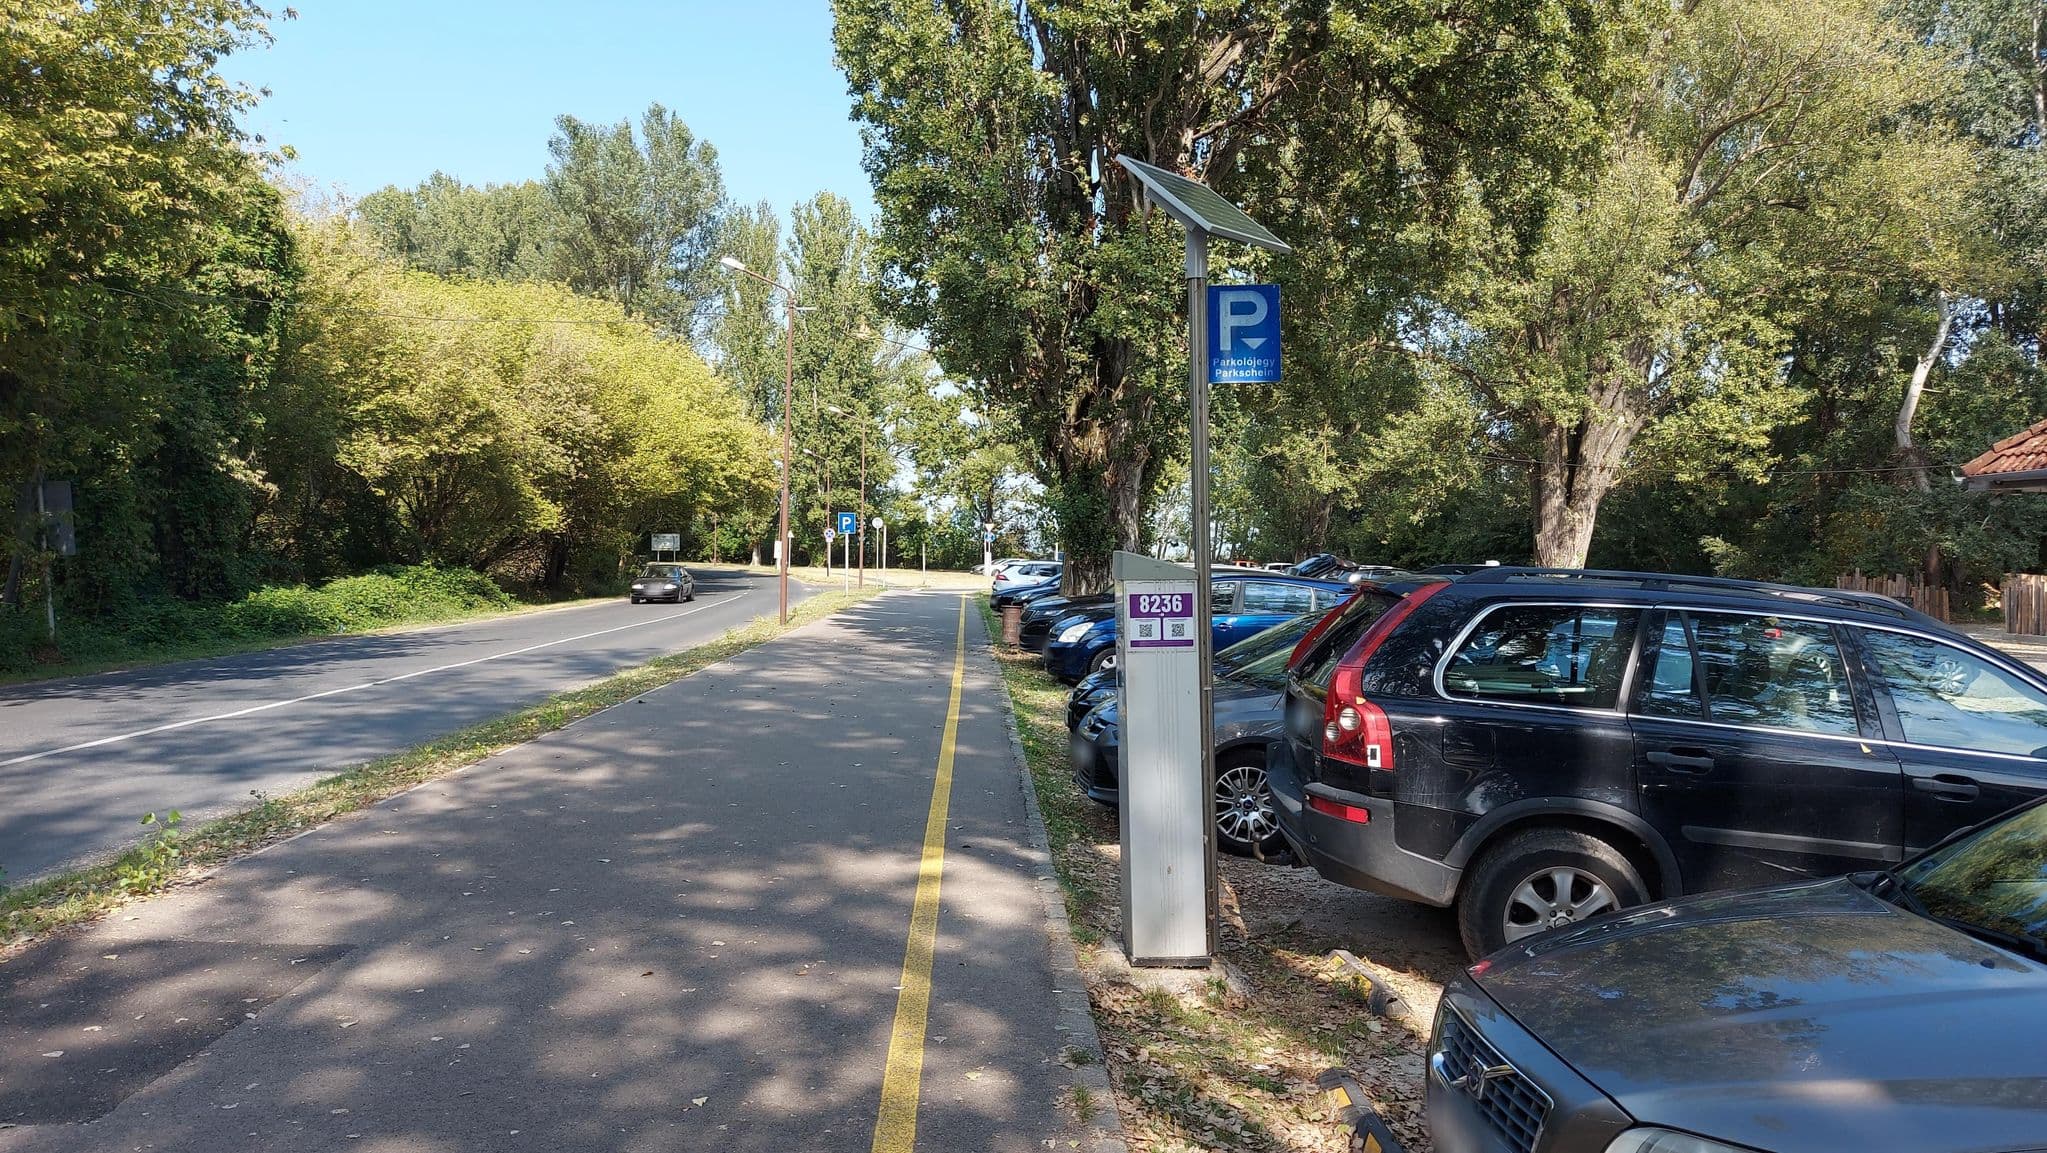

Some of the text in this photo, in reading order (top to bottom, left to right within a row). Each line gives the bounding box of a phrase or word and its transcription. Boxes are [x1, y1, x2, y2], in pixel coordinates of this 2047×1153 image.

[1219, 290, 1268, 351] P
[1213, 356, 1275, 367] Parkolójegy
[1215, 368, 1273, 377] Parkschein
[842, 516, 852, 530] P
[1139, 595, 1182, 613] 8236
